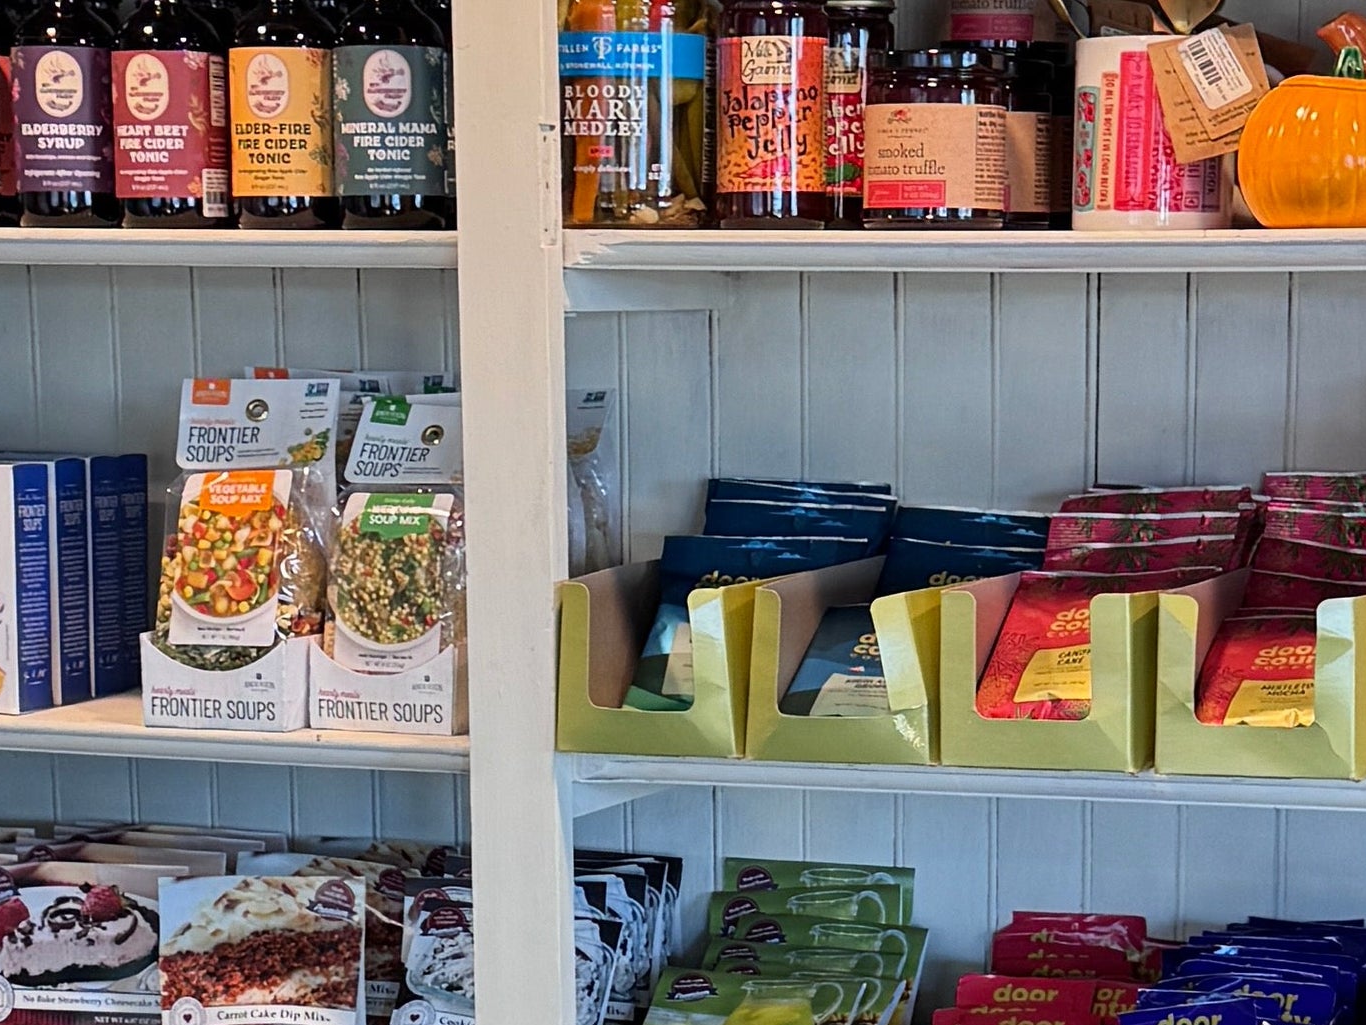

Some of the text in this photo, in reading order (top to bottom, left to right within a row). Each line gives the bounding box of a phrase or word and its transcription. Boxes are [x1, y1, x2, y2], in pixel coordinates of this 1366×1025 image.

[565, 85, 645, 98] BLOODY
[564, 100, 645, 120] MARY
[21, 123, 103, 136] ELDERBERRY
[154, 124, 189, 137] BEET
[235, 123, 312, 136] ELDER-FIRE
[341, 122, 396, 134] MINERAL
[564, 121, 644, 136] MEDLEY
[37, 137, 85, 150] SYRUP
[144, 138, 185, 150] CIDER
[238, 138, 308, 150] FIRE CIDER
[353, 135, 425, 148] FIRE CIDER
[129, 150, 169, 163] TONIC
[249, 151, 291, 164] TONIC
[367, 149, 411, 161] TONIC
[878, 142, 925, 159] smoked
[902, 159, 946, 176] truffle
[187, 425, 261, 446] FRONTIER
[185, 445, 236, 464] SOUPS
[359, 442, 430, 462] FRONTIER
[353, 460, 403, 478] SOUPS
[151, 698, 276, 722] FRONTIER SOUPS
[317, 698, 444, 725] FRONTIER SOUPS
[993, 983, 1059, 1003] door
[217, 1008, 302, 1023] Carrot Cake Dip
